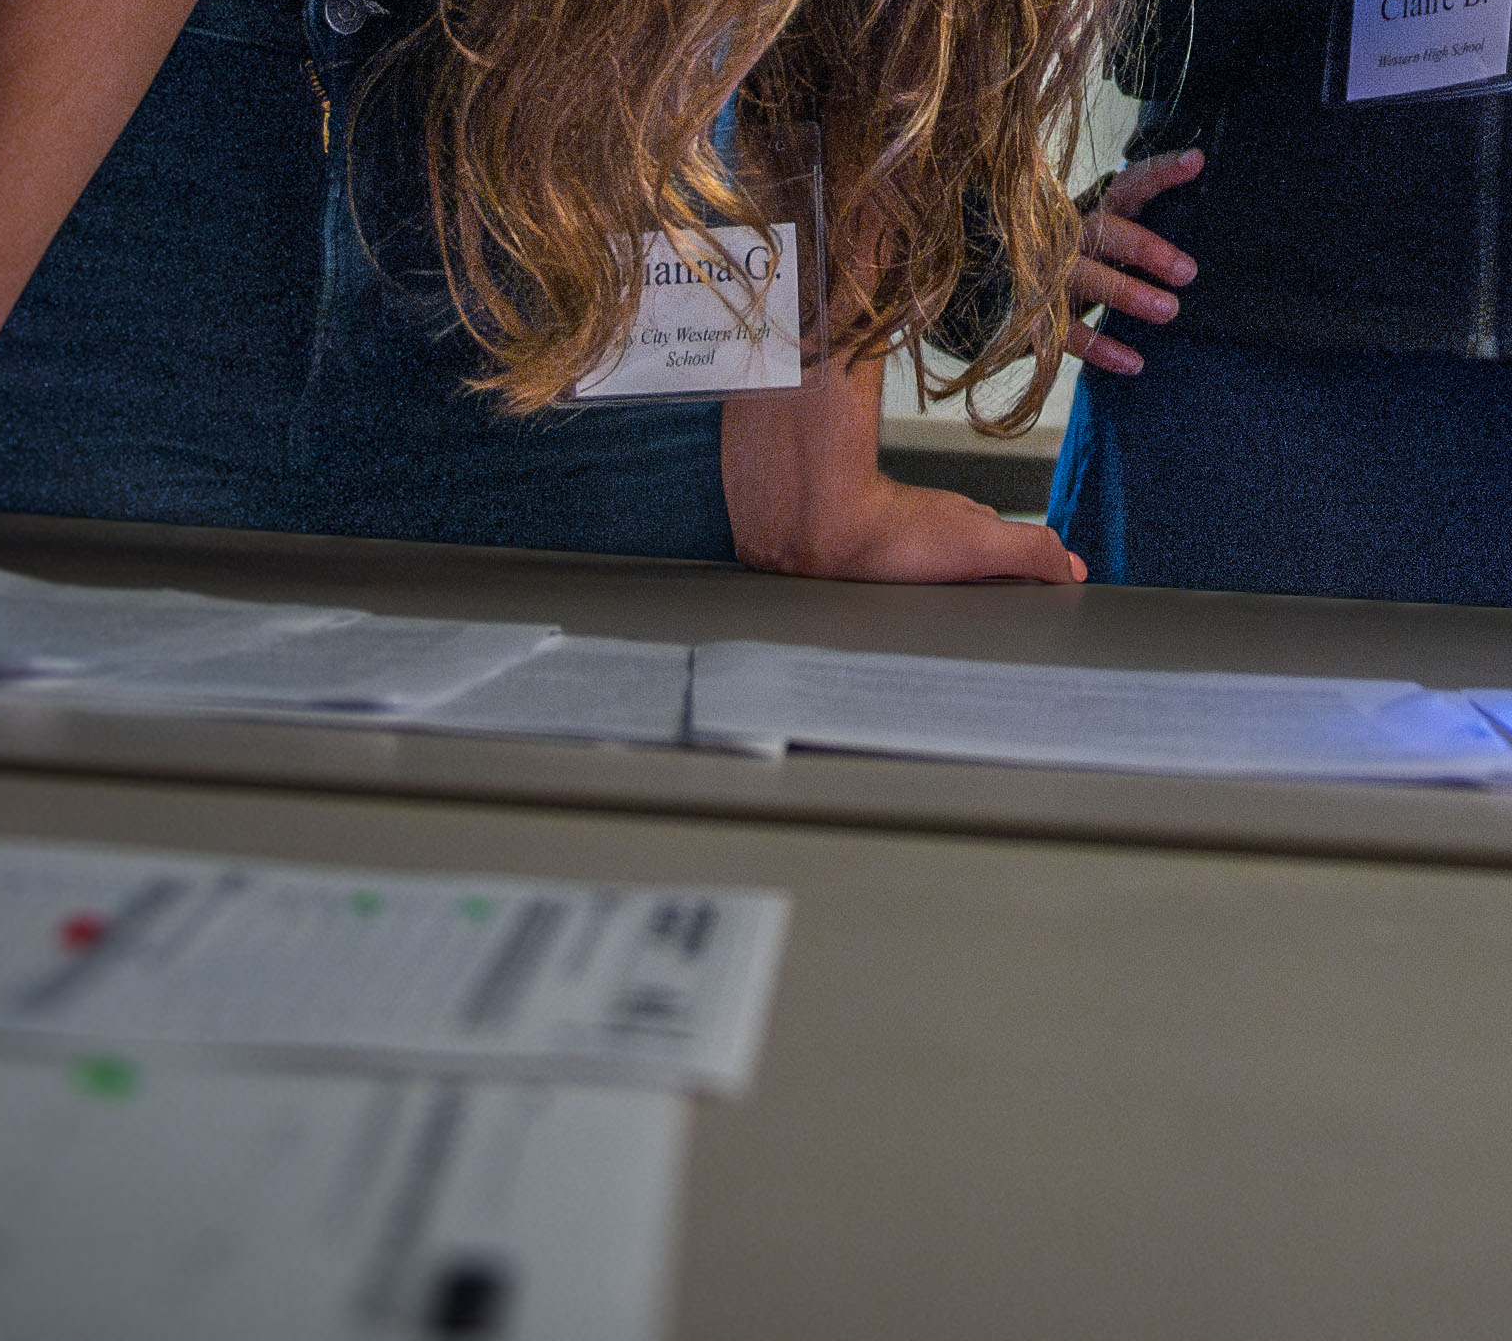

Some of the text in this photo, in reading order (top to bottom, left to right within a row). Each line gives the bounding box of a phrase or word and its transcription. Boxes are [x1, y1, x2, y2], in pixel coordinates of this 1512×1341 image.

[1423, 45, 1449, 63] High
[1451, 37, 1486, 57] School
[643, 245, 781, 287] ianna G.
[641, 327, 672, 348] City
[676, 325, 732, 343] Western
[665, 349, 716, 368] School
